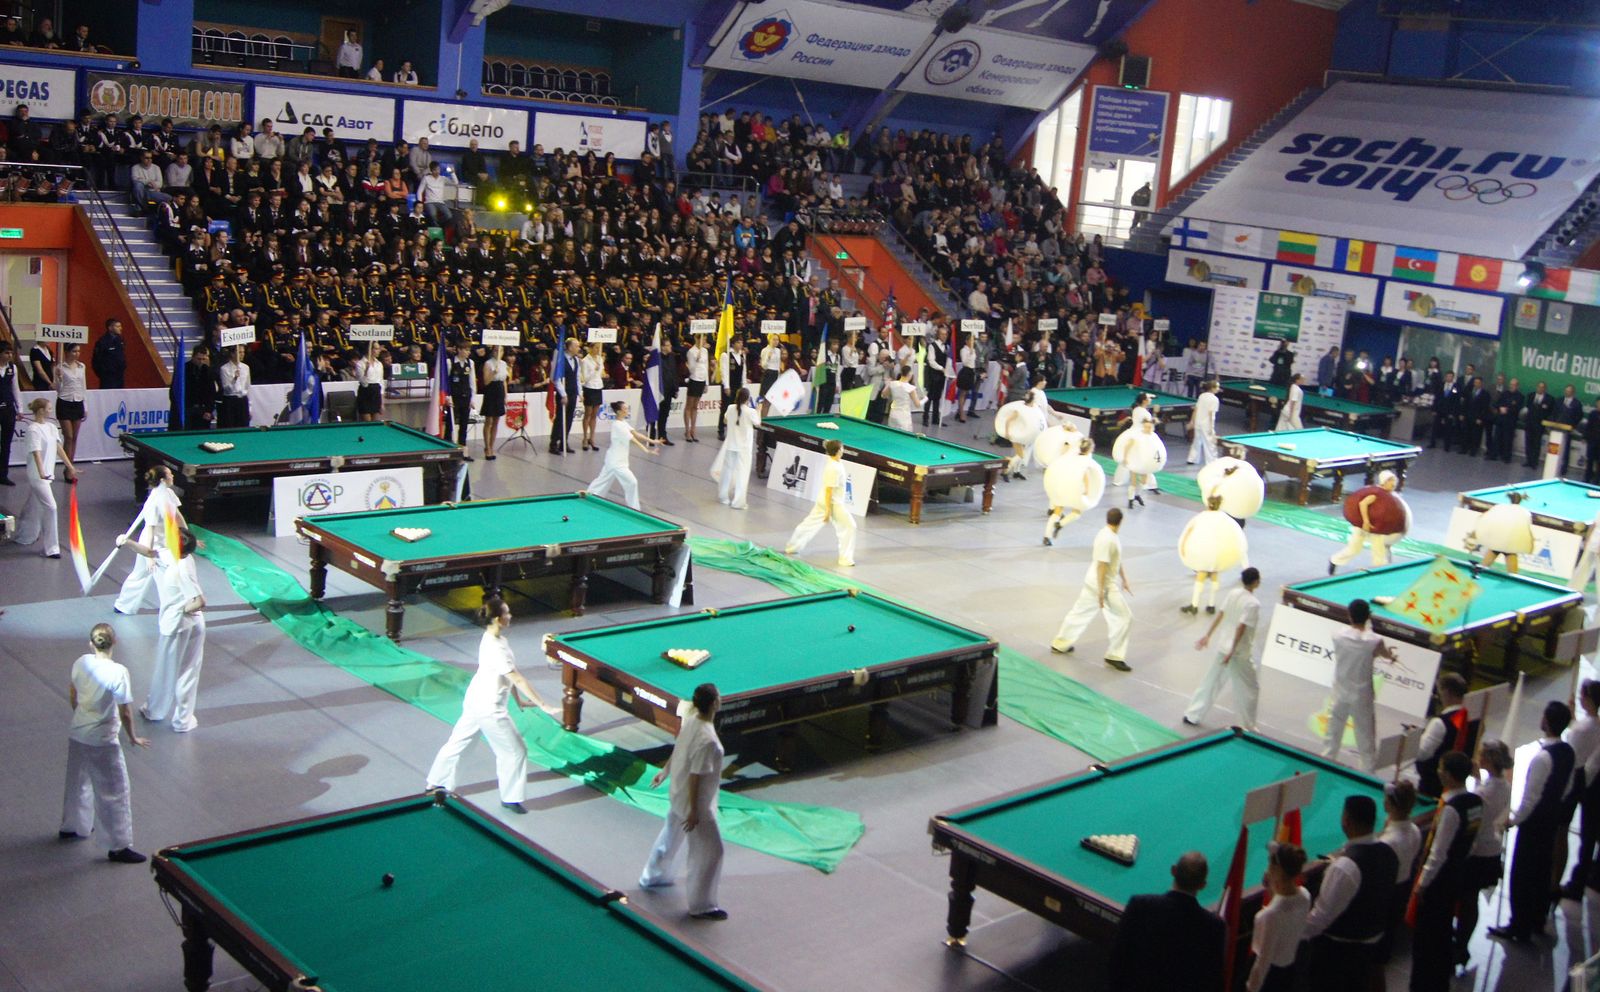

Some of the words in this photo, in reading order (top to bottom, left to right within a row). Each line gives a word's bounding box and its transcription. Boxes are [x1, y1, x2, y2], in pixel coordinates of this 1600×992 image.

[806, 32, 873, 52] Федерация
[872, 43, 911, 57] дзюдо
[791, 51, 834, 66] России
[129, 84, 200, 119] ЗОЛОТАЯ
[204, 90, 242, 122] СОВА
[336, 116, 373, 131] Азот
[1279, 132, 1566, 180] sochi.ru
[1284, 158, 1438, 202] 2014
[41, 326, 83, 340] Russia
[351, 327, 392, 338] Scotland
[962, 320, 983, 330] Serbia
[222, 330, 254, 342] Estonia
[1521, 346, 1568, 374] World
[128, 410, 170, 426] ГАЗПРО
[1154, 450, 1161, 463] 4
[1275, 632, 1334, 661] СТЕРХ
[1395, 674, 1426, 691] АВТО
